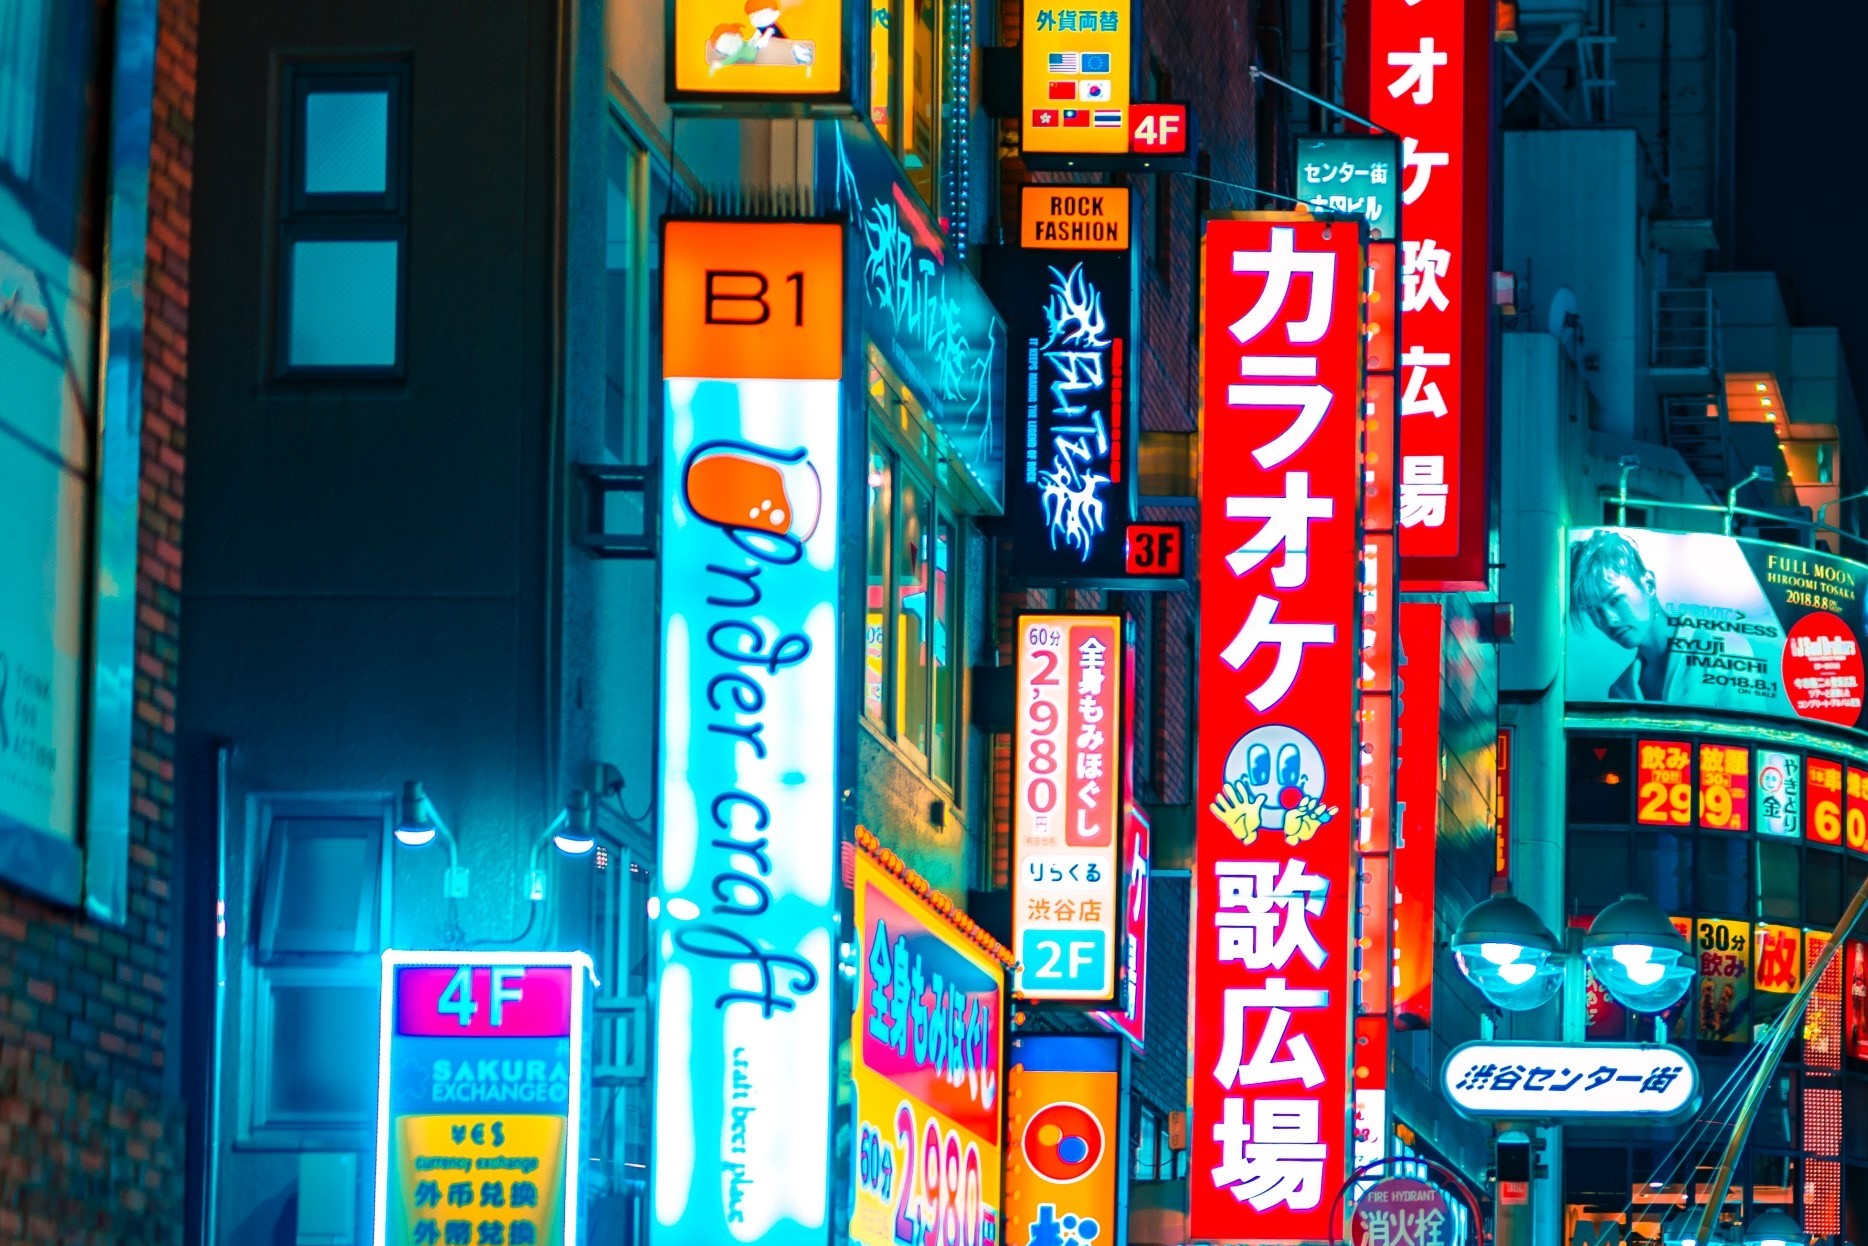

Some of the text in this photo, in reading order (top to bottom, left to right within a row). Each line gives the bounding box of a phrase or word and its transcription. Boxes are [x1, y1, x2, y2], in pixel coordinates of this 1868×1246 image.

[1036, 9, 1119, 33] 外貨両替
[1134, 113, 1181, 146] 4F
[1304, 161, 1388, 185] センター街
[1050, 196, 1104, 218] ROCK
[1034, 219, 1119, 243] FASHION
[1387, 0, 1452, 529] オケ歌広場
[703, 269, 806, 327] B1
[1134, 532, 1176, 568] 3F
[1768, 555, 1856, 588] FULL MOON
[1768, 572, 1856, 601] HIROOMI TOSAKA
[1028, 627, 1062, 647] 60分
[1667, 616, 1778, 638] DARKNESS
[1686, 655, 1768, 675] IMAICHI
[1702, 673, 1778, 693] 2018.8.1
[1754, 689, 1778, 699] SALE
[1211, 226, 1338, 1213] カラオケ 歌広場
[1076, 636, 1107, 838] 全身もみほぐし
[1763, 796, 1782, 819] 金
[1783, 758, 1799, 834] やきとり
[1029, 861, 1102, 884] りらくる
[1028, 898, 1102, 922] 渋谷店
[1700, 922, 1747, 951] 30分
[1035, 938, 1097, 979] 2F
[1700, 952, 1747, 978] 飲み
[437, 966, 526, 1027] 4F
[868, 917, 997, 1110] 全身もみほぐし
[432, 1059, 568, 1082] SAKURA
[1456, 1064, 1682, 1096] 渋谷センター街
[432, 1083, 550, 1101] EXCHANGE
[860, 1126, 893, 1200] 60分
[1367, 1190, 1435, 1203] FIRE HYDRANT
